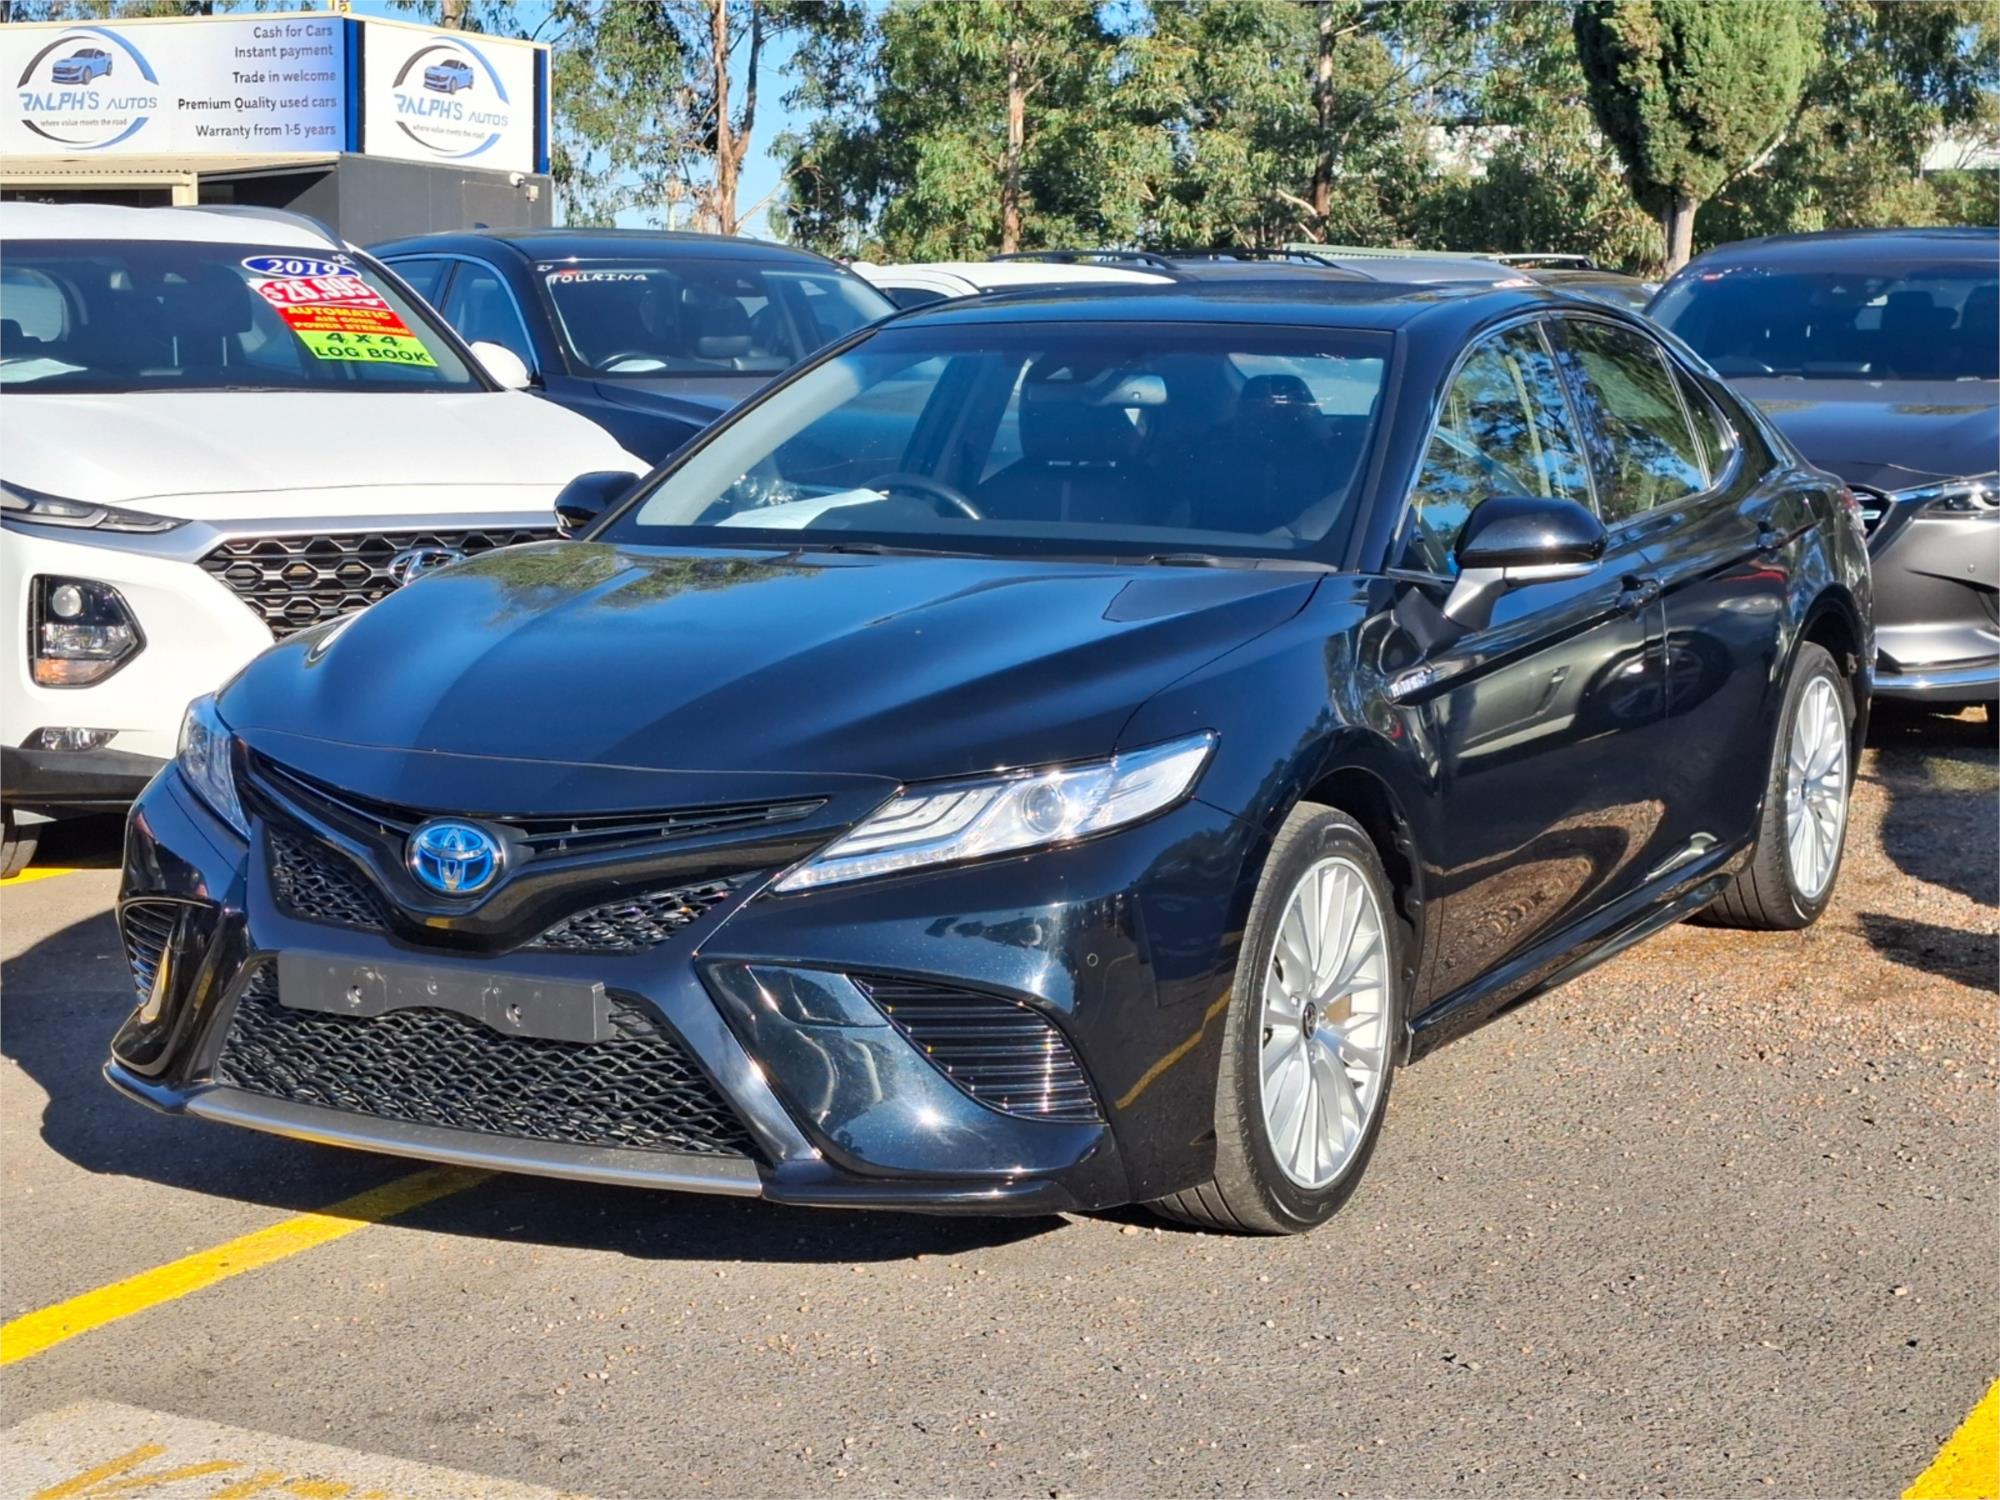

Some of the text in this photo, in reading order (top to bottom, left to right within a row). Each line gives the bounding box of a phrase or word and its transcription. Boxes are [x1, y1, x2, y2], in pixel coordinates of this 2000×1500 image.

[253, 24, 334, 38] Cash for Cars
[234, 45, 333, 60] Instant payment
[232, 69, 336, 83] Trade in welcome
[19, 91, 158, 111] RALPH'S AUTOS
[178, 97, 337, 112] Premium Quality used cars
[394, 94, 509, 127] RALPH'S AUTOS
[196, 124, 337, 140] Warranty from 1-5 years
[267, 259, 340, 275] 2019
[262, 277, 371, 301] $26,995
[288, 306, 391, 320] AUTOMATIC
[293, 322, 410, 334] POWER STEERING
[326, 332, 344, 343] 4
[380, 336, 399, 347] 4
[314, 346, 430, 362] LOG BOOK
